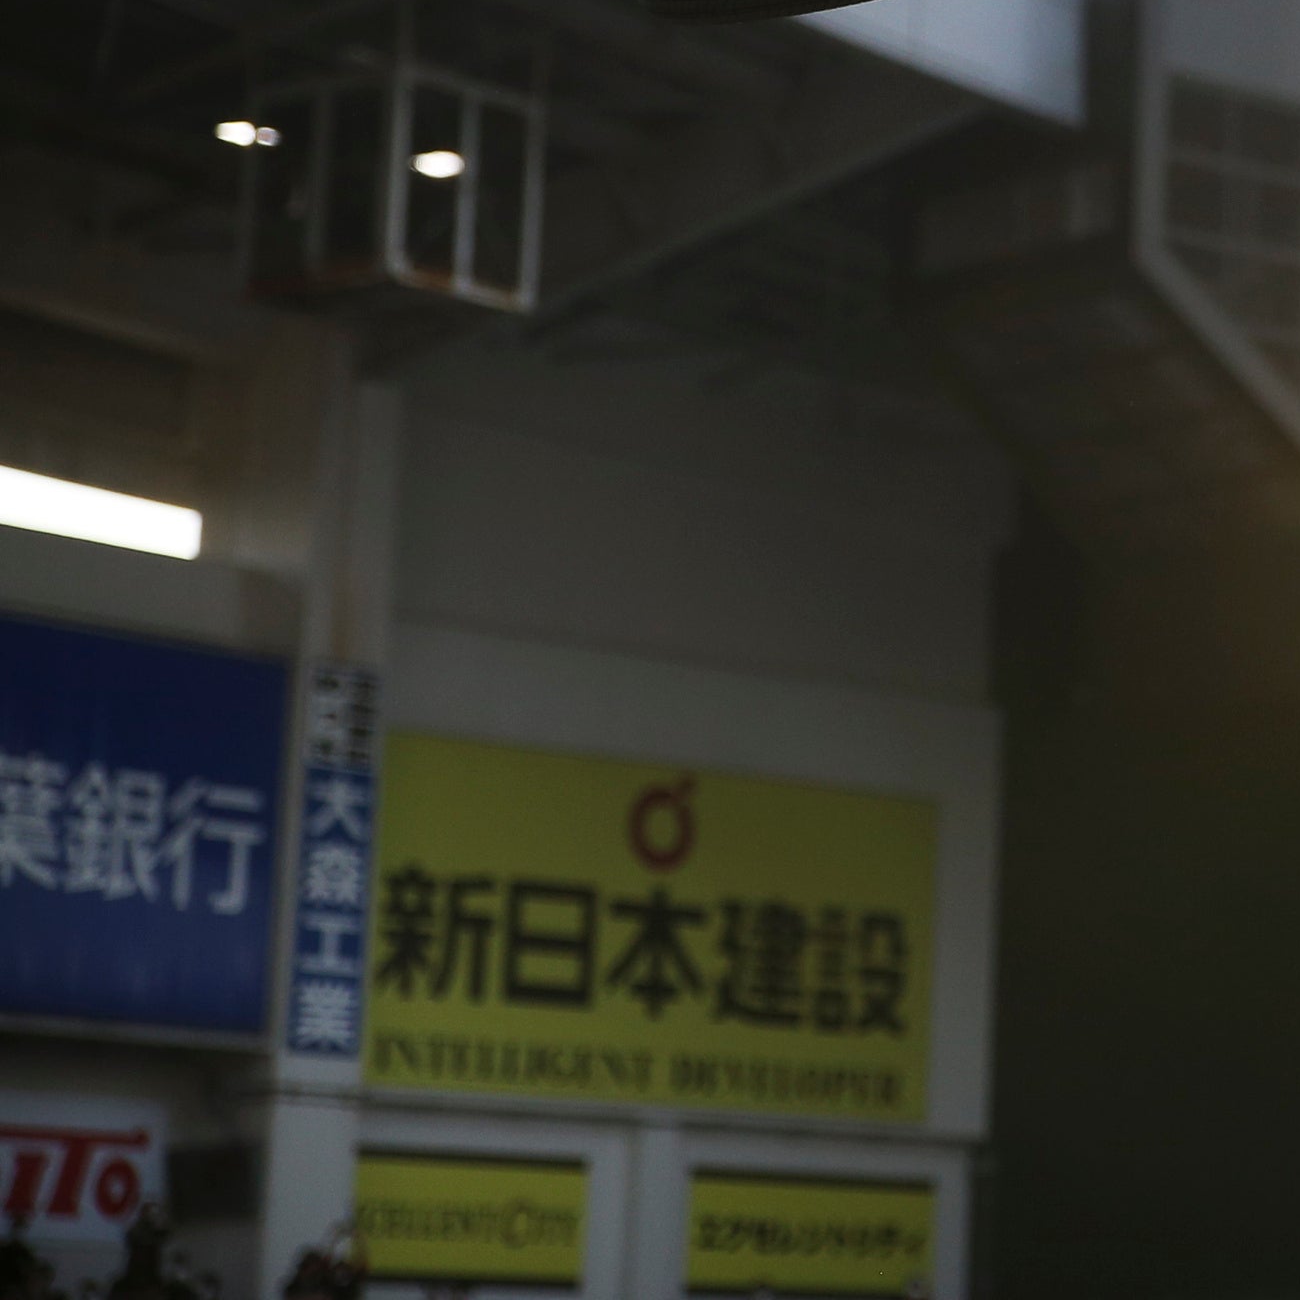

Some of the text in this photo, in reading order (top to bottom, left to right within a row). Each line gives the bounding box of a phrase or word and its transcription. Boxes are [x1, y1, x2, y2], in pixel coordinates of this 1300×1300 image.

[374, 862, 908, 1038] 新日本建設
